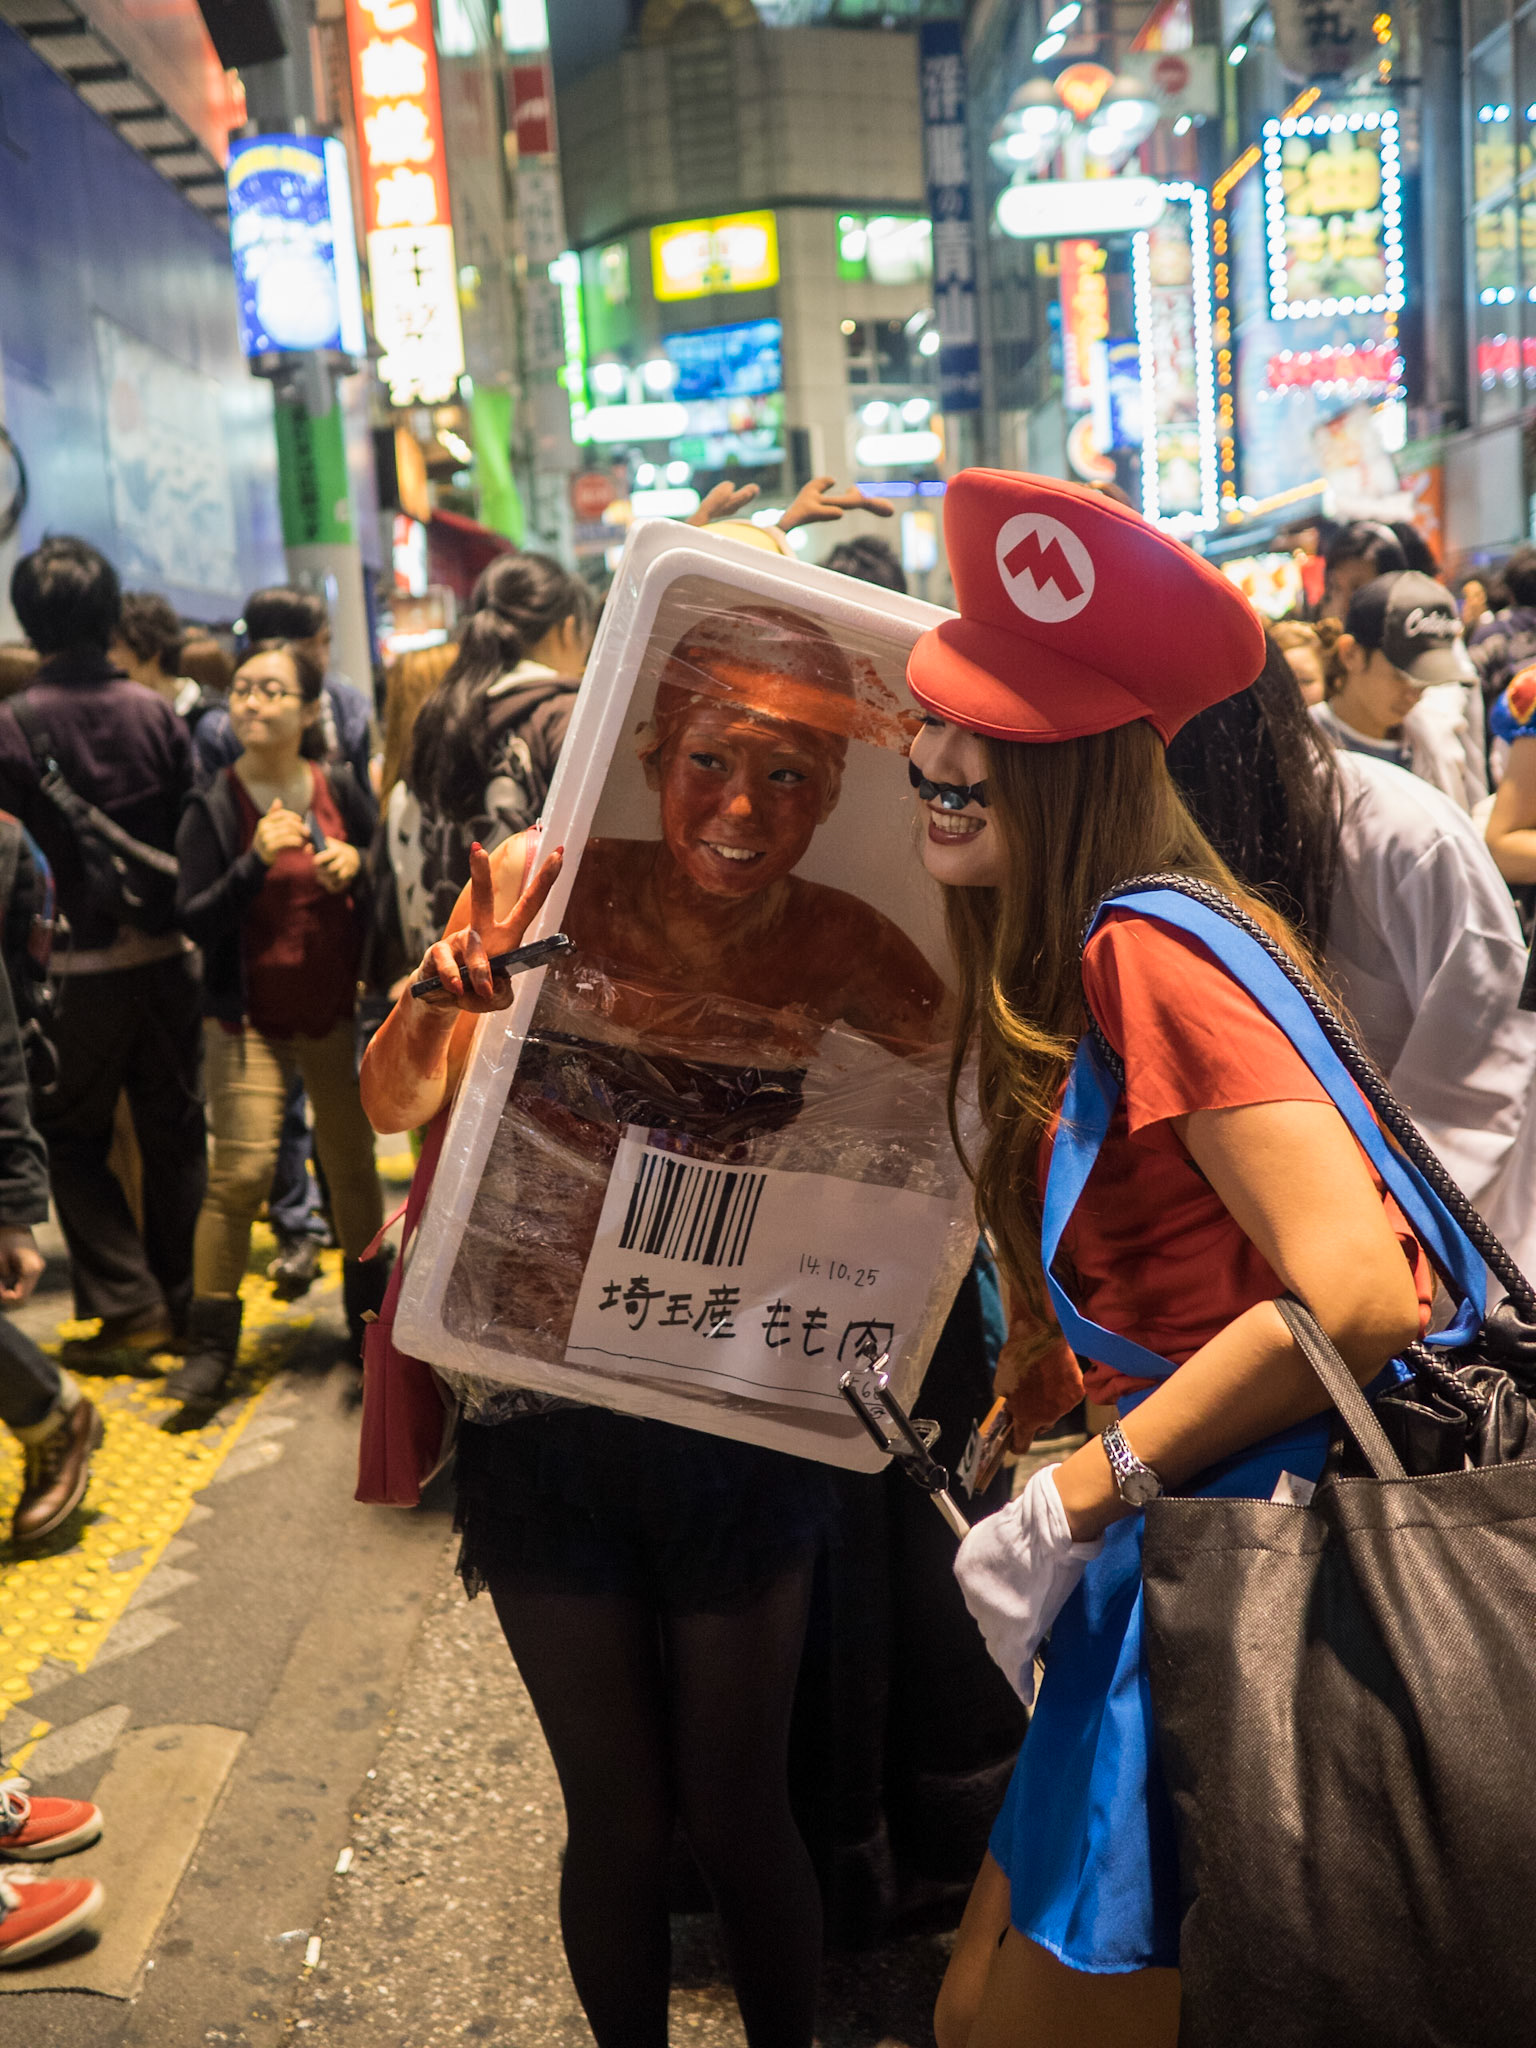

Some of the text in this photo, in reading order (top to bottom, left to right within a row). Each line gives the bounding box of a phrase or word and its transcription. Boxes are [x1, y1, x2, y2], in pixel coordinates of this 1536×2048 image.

[1002, 529, 1085, 602] M
[799, 1252, 880, 1288] 14.10.25
[598, 1273, 896, 1365] 埼玉産 もも肉
